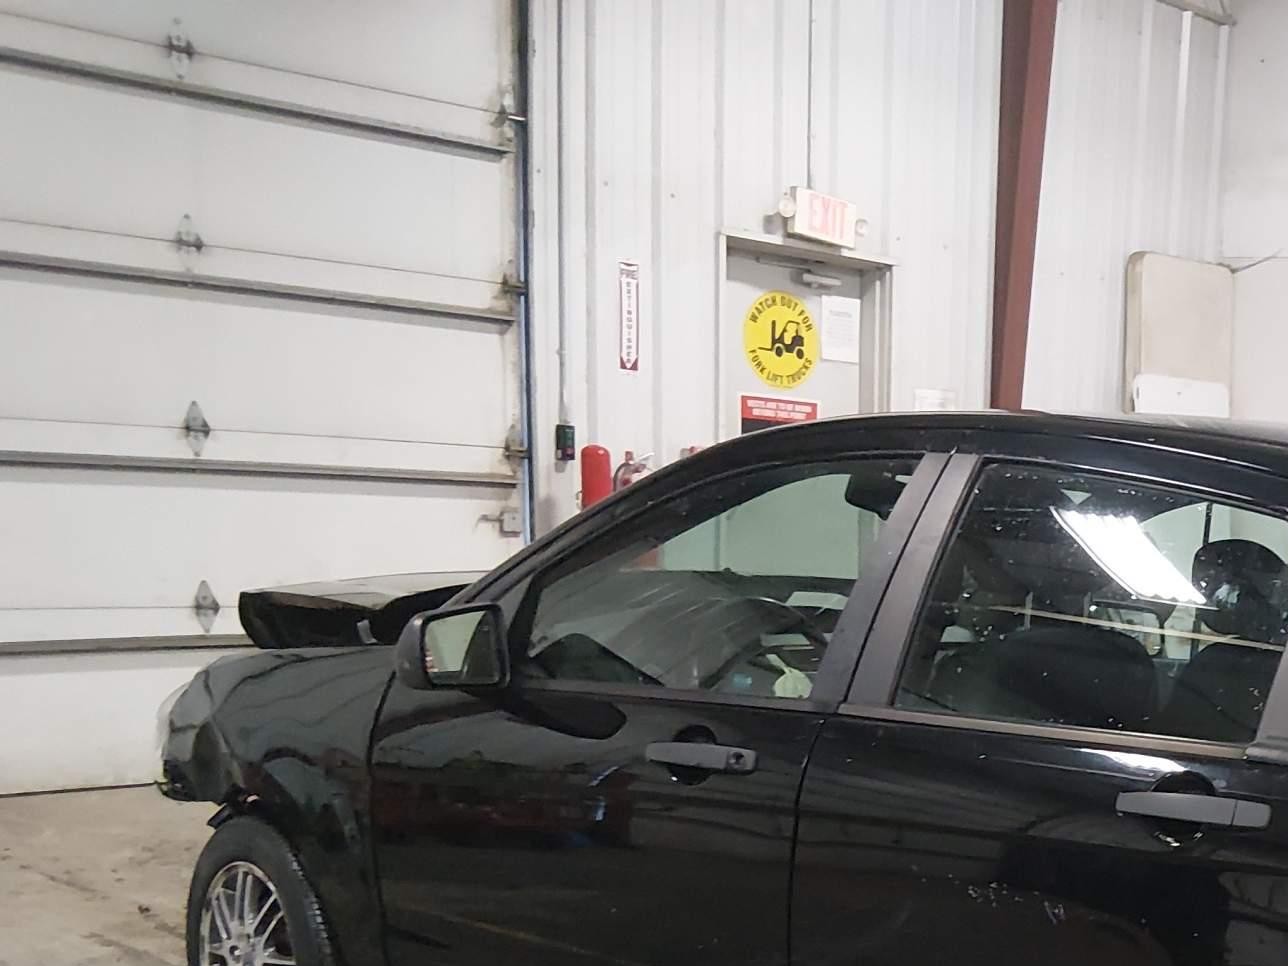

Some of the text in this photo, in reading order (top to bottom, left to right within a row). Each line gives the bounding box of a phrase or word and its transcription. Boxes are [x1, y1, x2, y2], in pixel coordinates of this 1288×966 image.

[808, 193, 848, 240] EXIT
[749, 295, 813, 332] WATCH OUT FOR
[748, 349, 813, 385] FORK LIFT TRUCKS
